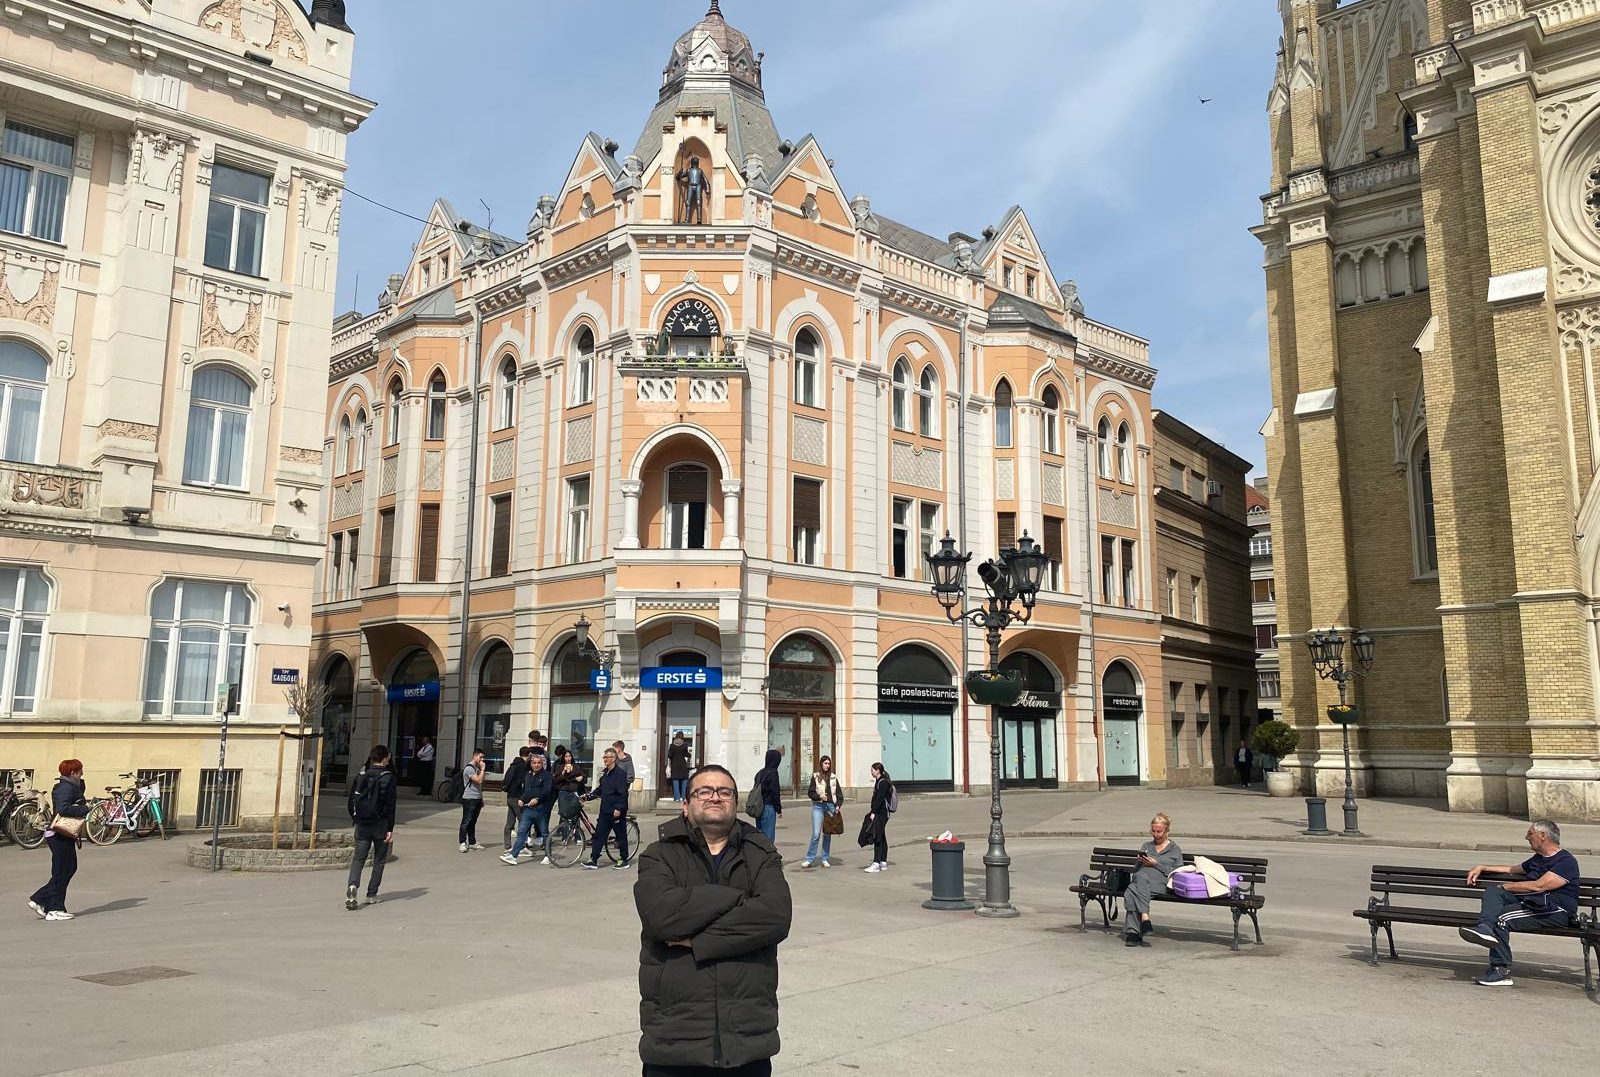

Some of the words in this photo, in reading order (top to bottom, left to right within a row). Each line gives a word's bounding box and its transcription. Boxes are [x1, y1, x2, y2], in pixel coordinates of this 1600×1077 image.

[694, 300, 718, 334] QUEEN
[657, 673, 693, 683] ERSTE
[404, 688, 420, 697] ERSTE
[881, 686, 899, 696] cafe
[1011, 689, 1050, 708] Atina
[1112, 698, 1139, 706] restoran
